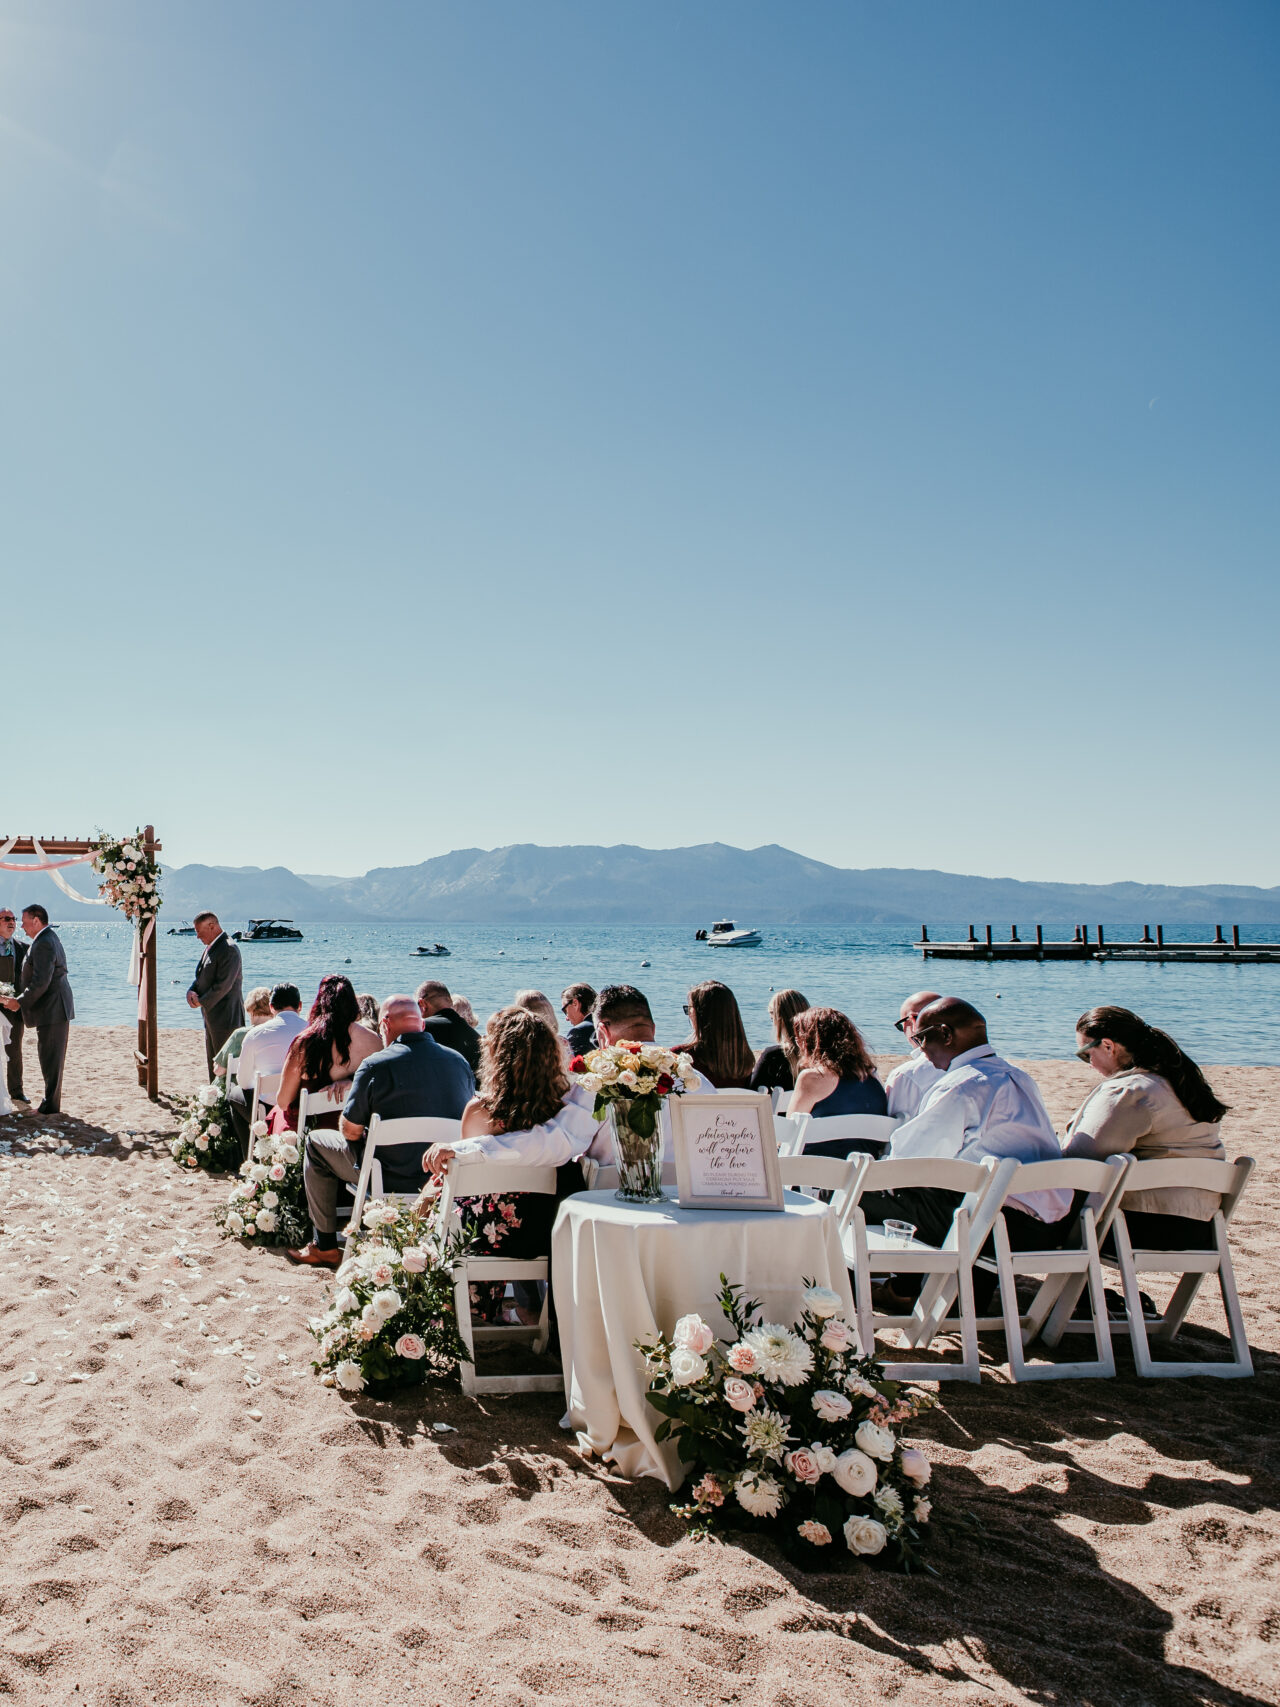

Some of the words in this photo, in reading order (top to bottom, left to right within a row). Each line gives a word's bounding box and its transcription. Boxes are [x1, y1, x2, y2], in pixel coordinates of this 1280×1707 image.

[715, 1113, 736, 1127] Our
[695, 1127, 756, 1145] photographer
[698, 1141, 718, 1154] will
[721, 1143, 754, 1160] capture
[710, 1156, 724, 1169] the
[729, 1156, 747, 1169] love
